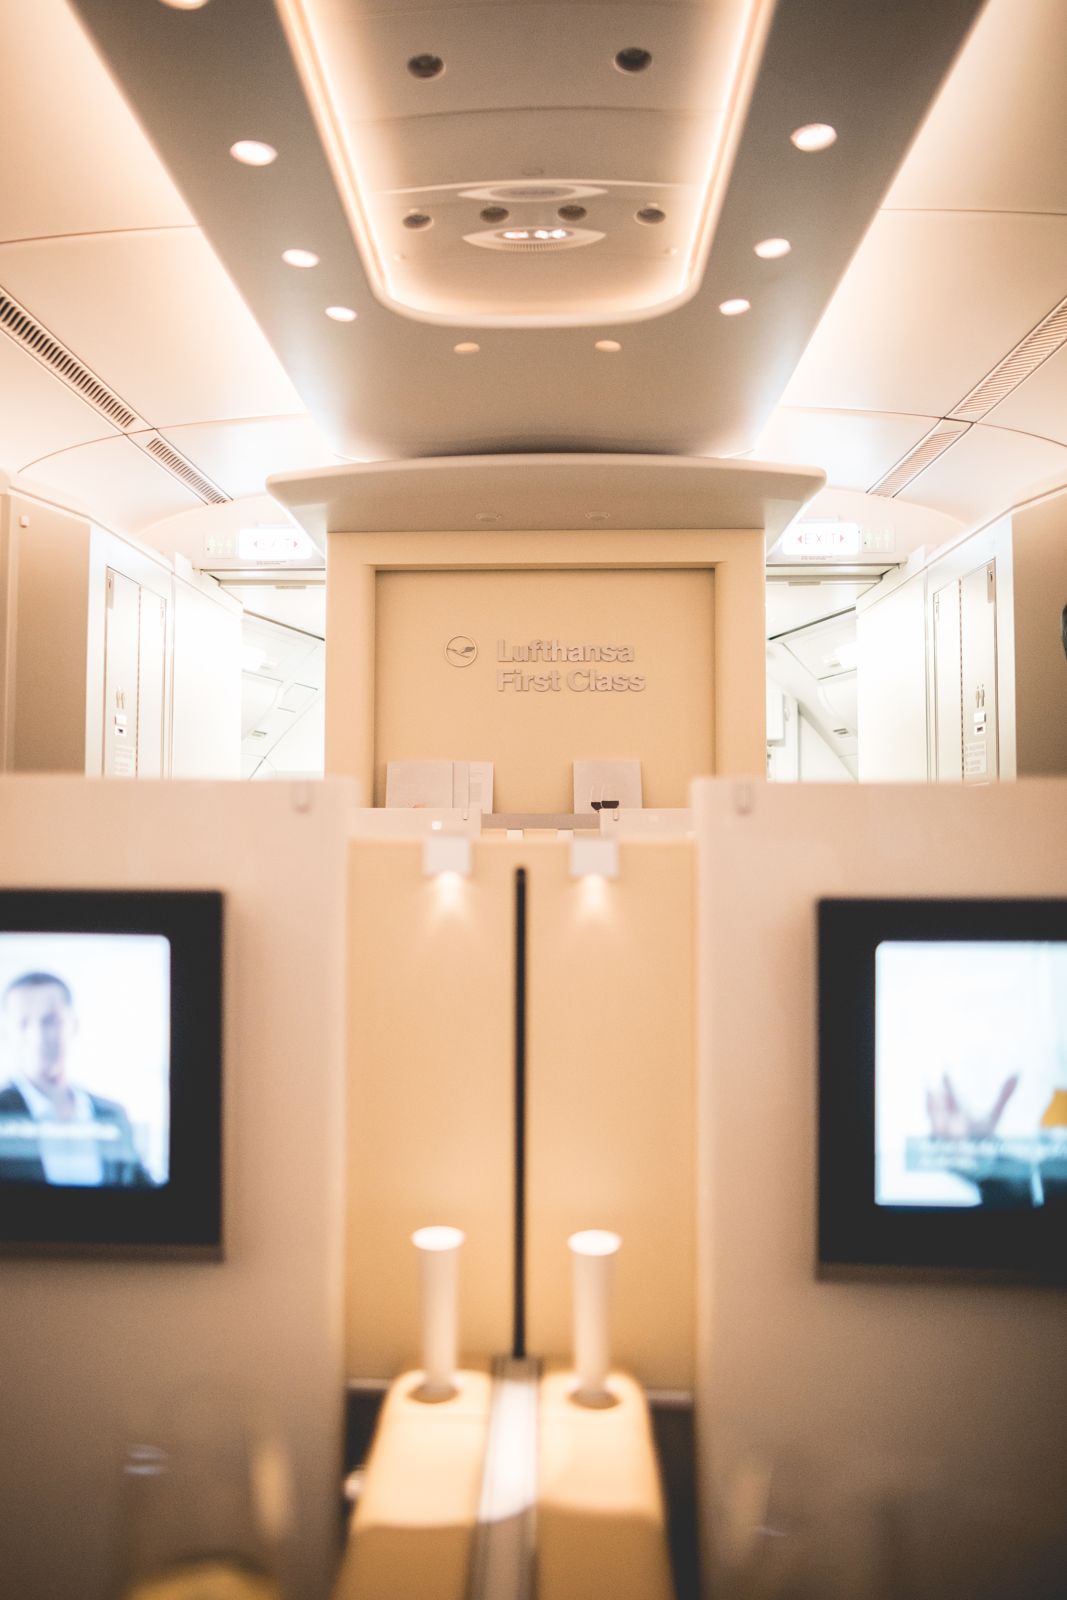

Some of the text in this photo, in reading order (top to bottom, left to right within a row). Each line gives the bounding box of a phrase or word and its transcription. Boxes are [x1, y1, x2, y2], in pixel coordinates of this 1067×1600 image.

[497, 639, 635, 662] Lufthansa
[496, 669, 646, 692] First Class
